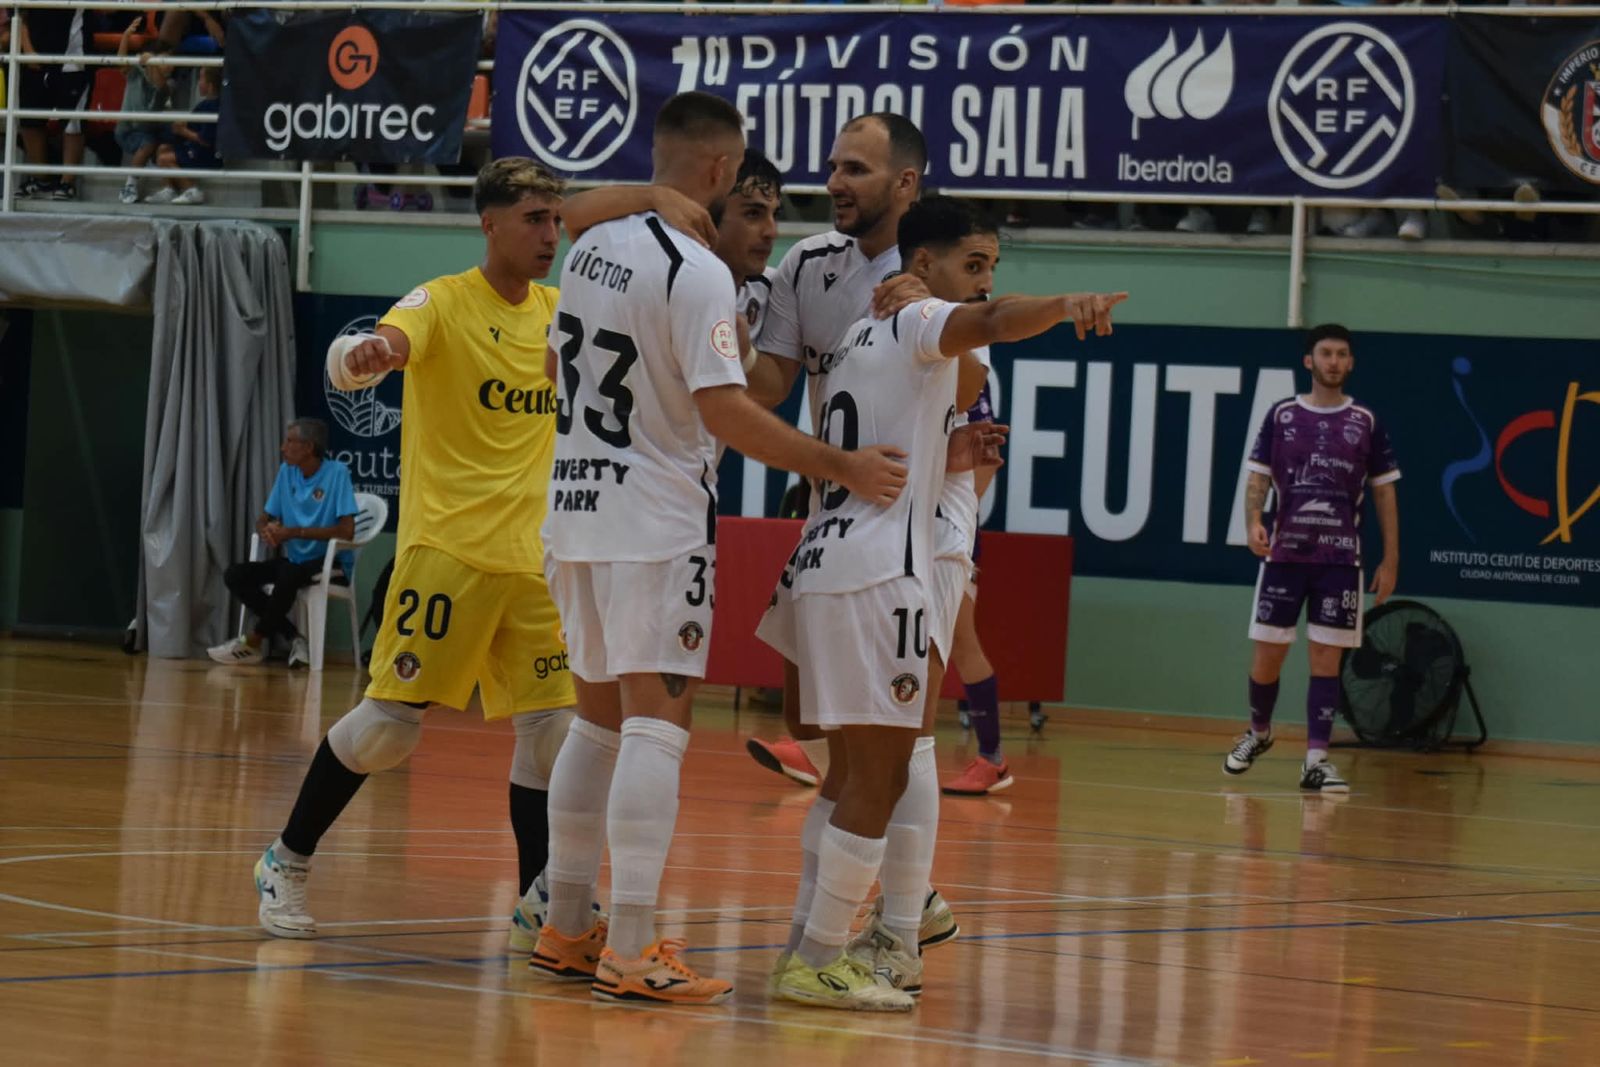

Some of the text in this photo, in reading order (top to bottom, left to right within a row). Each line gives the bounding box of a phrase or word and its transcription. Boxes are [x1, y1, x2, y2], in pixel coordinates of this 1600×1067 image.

[742, 25, 1088, 72] DIVISIÓN
[1558, 47, 1599, 84] IMPERIO
[949, 84, 1087, 179] SALA
[1118, 153, 1234, 183] Iberdrola
[570, 246, 633, 294] VÍCTOR
[326, 446, 400, 479] eut
[984, 357, 1297, 548] EUTA
[554, 489, 600, 512] PARK
[1430, 550, 1600, 572] INSTITUTO CEUTÍ DE DEPORTES
[1460, 569, 1492, 580] CIUDAD
[1542, 574, 1553, 583] DE
[1554, 574, 1580, 585] CEUTA
[686, 555, 716, 609] 3
[1342, 589, 1357, 610] 88
[396, 588, 452, 641] 20
